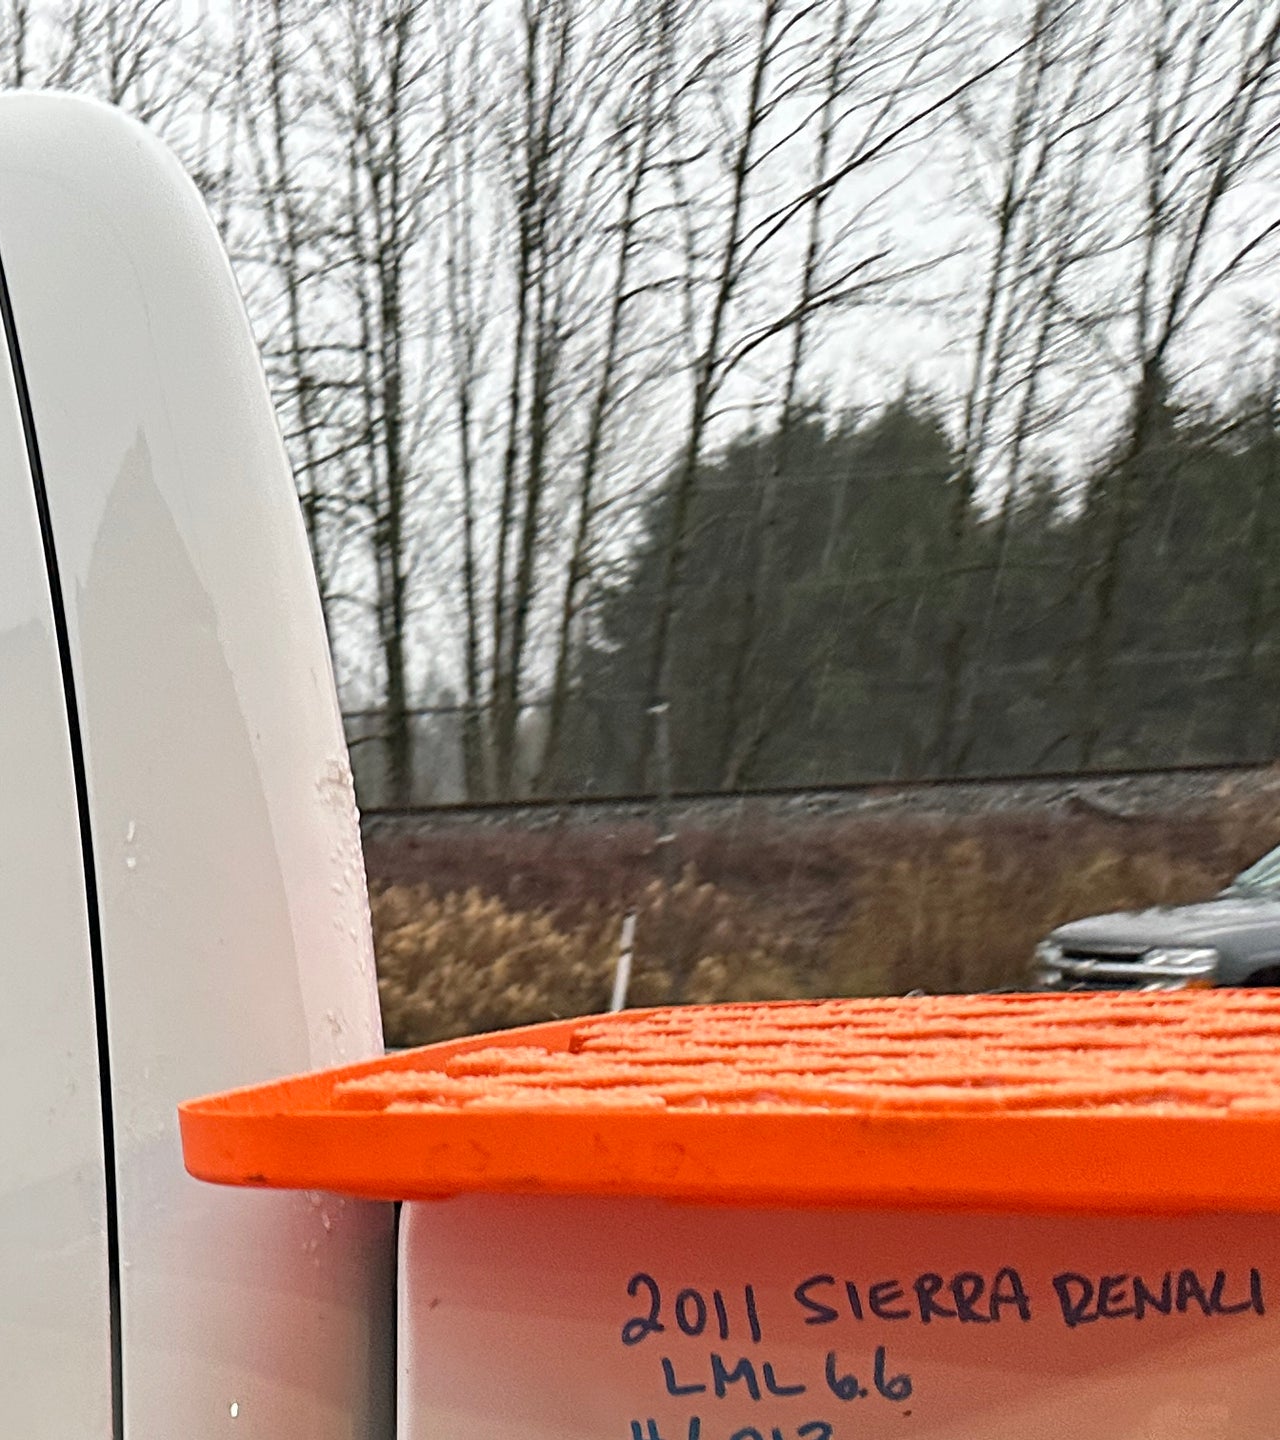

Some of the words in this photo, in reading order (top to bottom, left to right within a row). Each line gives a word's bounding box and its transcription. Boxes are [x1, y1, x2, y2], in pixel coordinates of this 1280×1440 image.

[620, 1272, 763, 1347] 2011
[793, 1266, 1032, 1326] SIERRA
[1051, 1268, 1267, 1329] RENALI
[660, 1353, 808, 1402] LML
[824, 1345, 914, 1402] 6.6
